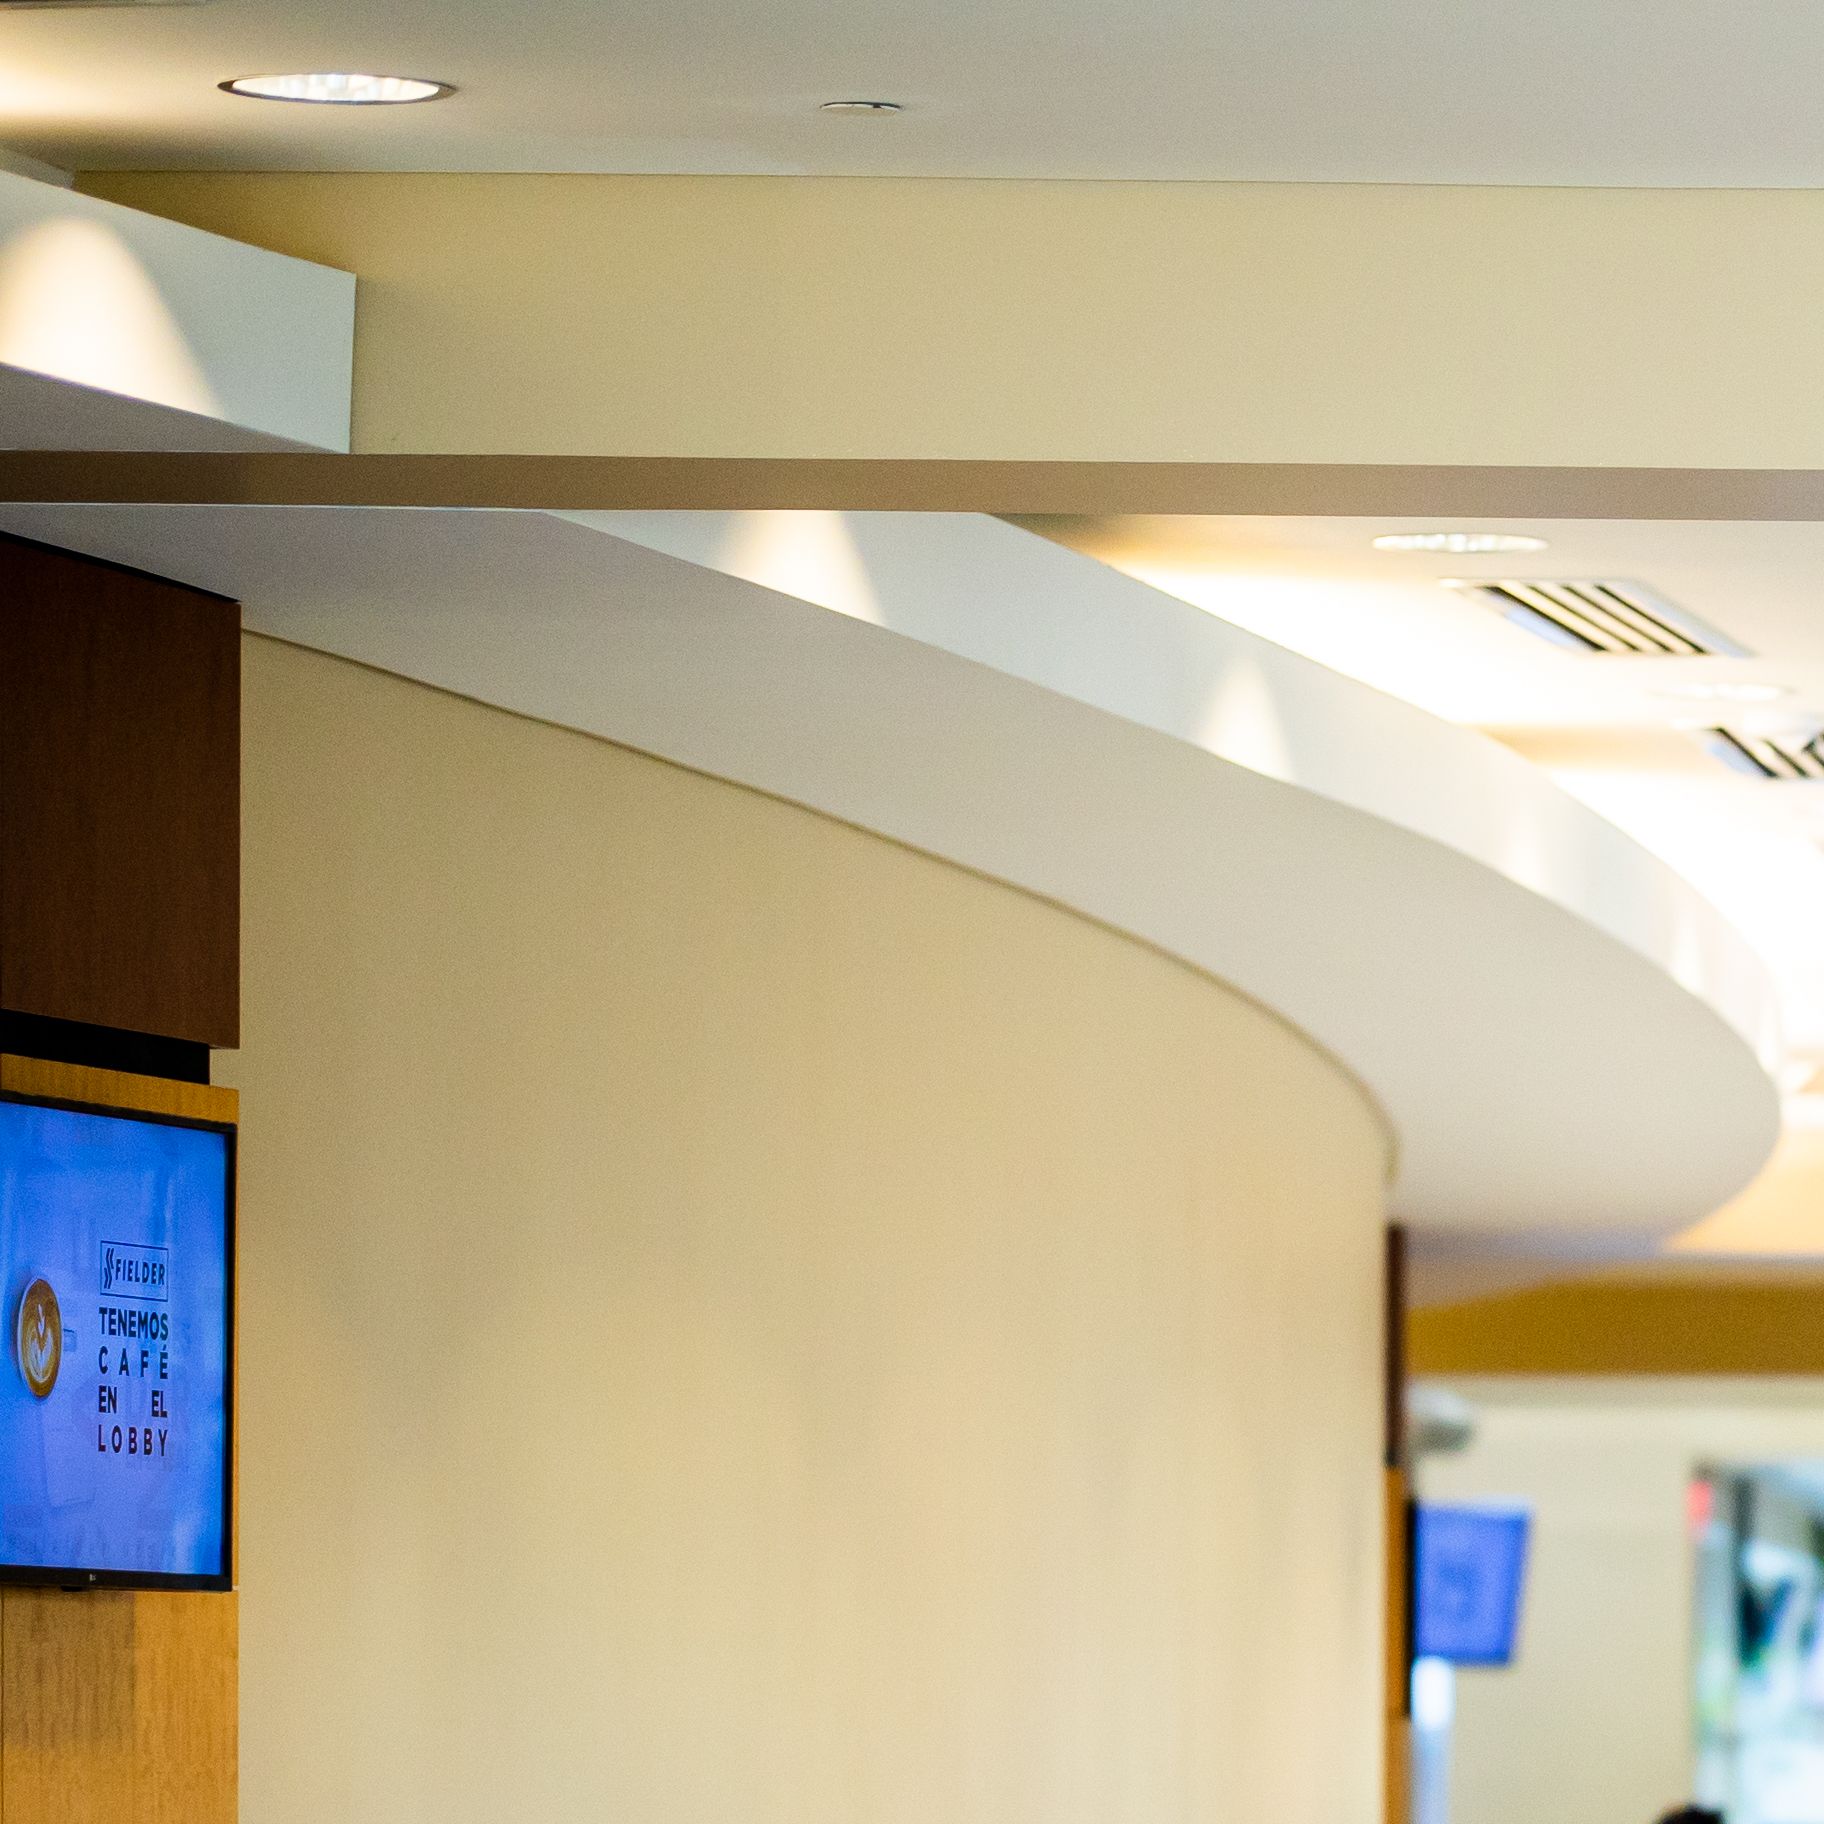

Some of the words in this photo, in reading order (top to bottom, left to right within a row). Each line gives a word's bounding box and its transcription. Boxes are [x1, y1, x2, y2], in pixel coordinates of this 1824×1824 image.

[115, 1258, 165, 1286] FIELDER
[99, 1307, 168, 1341] TENEMOS
[99, 1344, 168, 1380] CAFÉ
[99, 1385, 117, 1414] EN
[152, 1390, 168, 1418] EL
[98, 1424, 168, 1457] LOBBY
